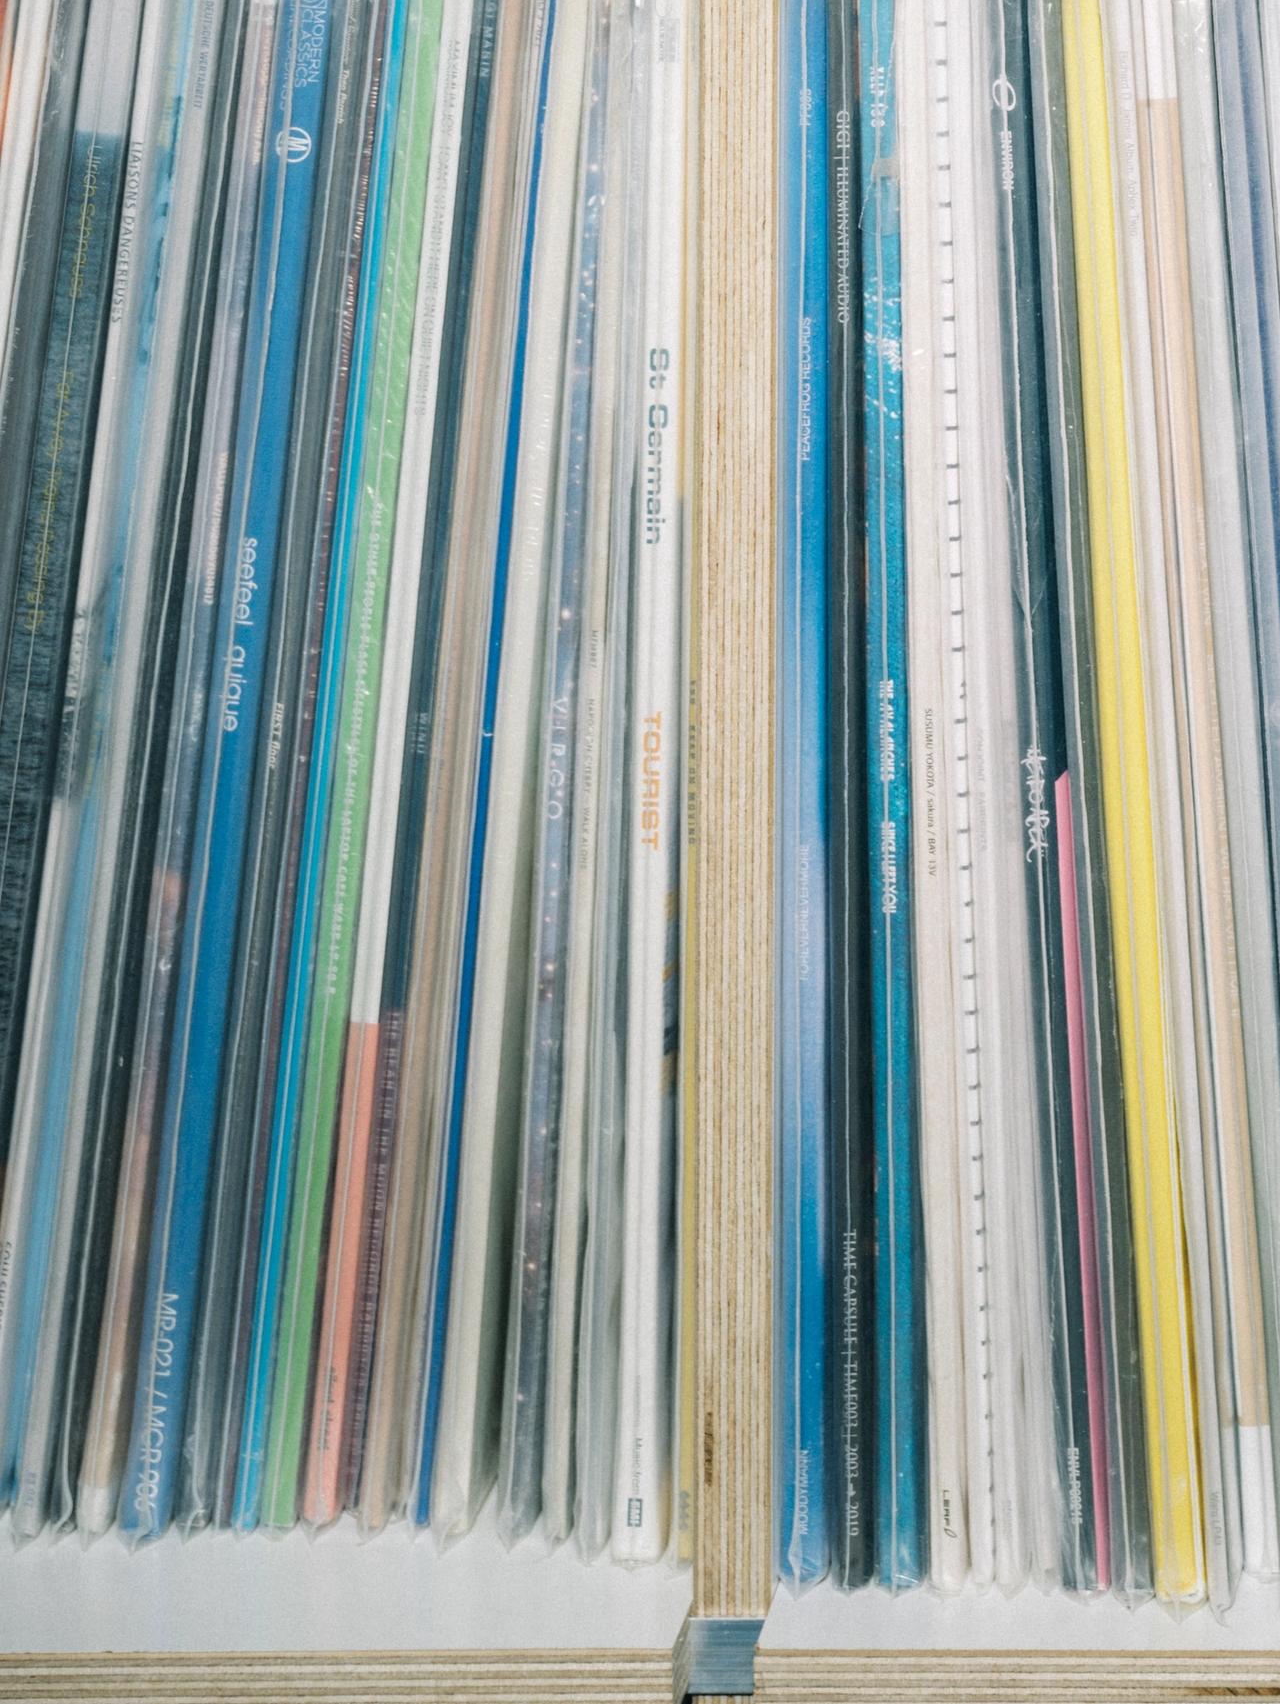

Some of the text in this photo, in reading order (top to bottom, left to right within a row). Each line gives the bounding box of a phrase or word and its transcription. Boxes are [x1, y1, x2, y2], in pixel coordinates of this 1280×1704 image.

[294, 8, 313, 87] CLASSICS
[307, 10, 325, 83] MODERN
[112, 215, 137, 323] DANGEREUSES
[836, 110, 851, 323] GIGI ILLUMINATED AUDIO
[646, 349, 670, 544] St Germain
[223, 537, 260, 732] seefeel quique
[641, 712, 662, 850] TOURIST
[923, 708, 937, 855] SUSUMU YOKOTA sakura BAY
[134, 1293, 180, 1511] MR-021 MCR 906
[842, 1229, 860, 1536] TIME CAPSULE TIME003 2003 2019
